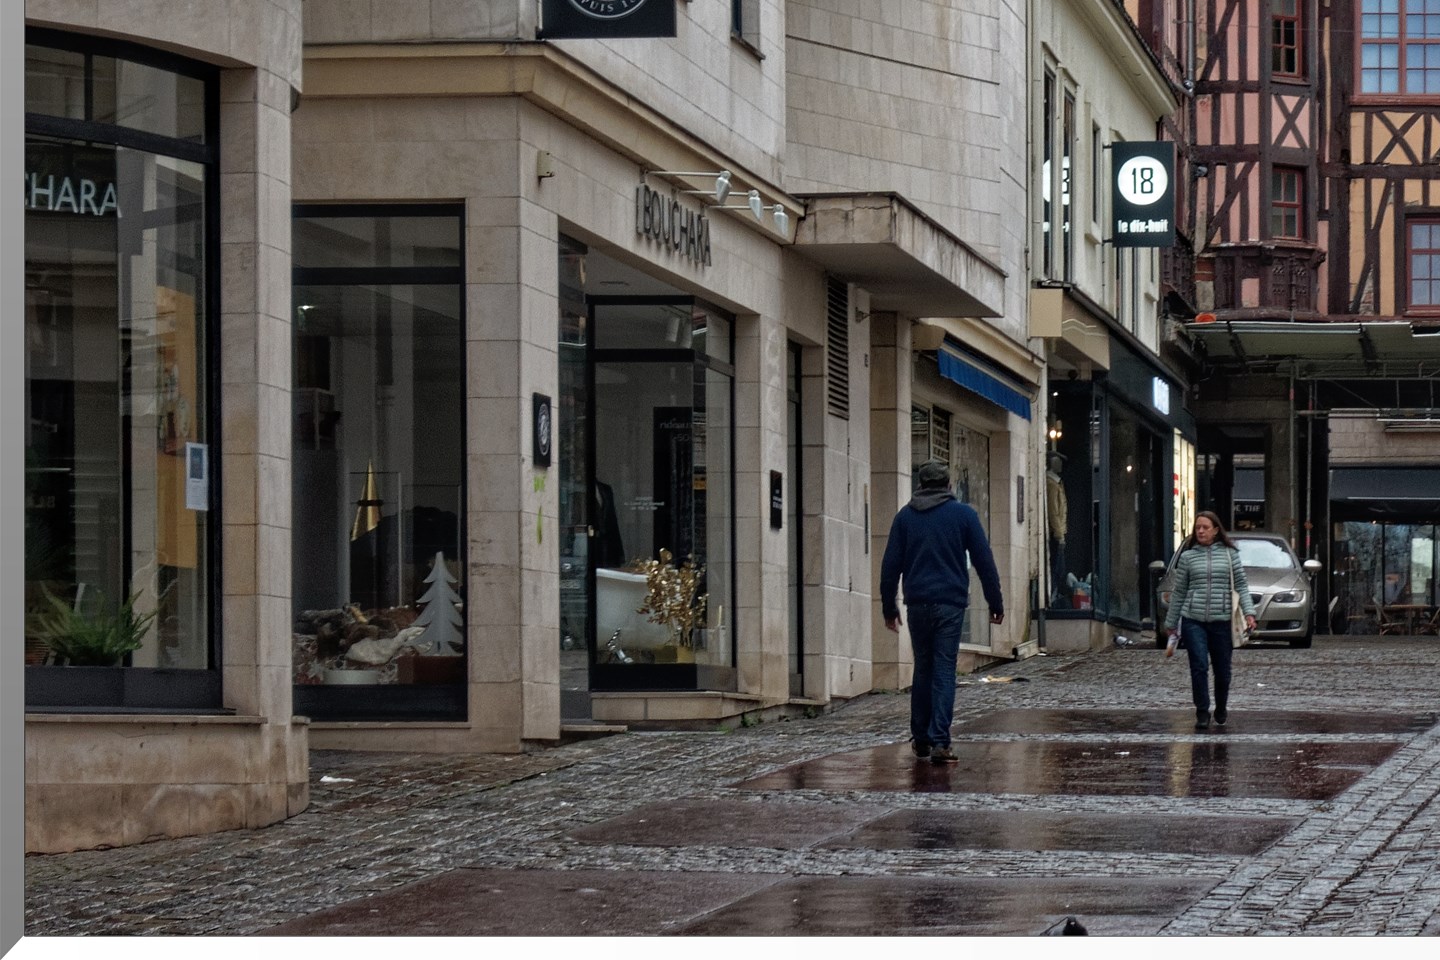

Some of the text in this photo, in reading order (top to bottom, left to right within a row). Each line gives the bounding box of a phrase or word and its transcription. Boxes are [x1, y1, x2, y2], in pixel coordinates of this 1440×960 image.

[1131, 167, 1154, 194] 18
[636, 183, 712, 267] BOUCHARA
[1117, 219, 1169, 233] le dix-huit
